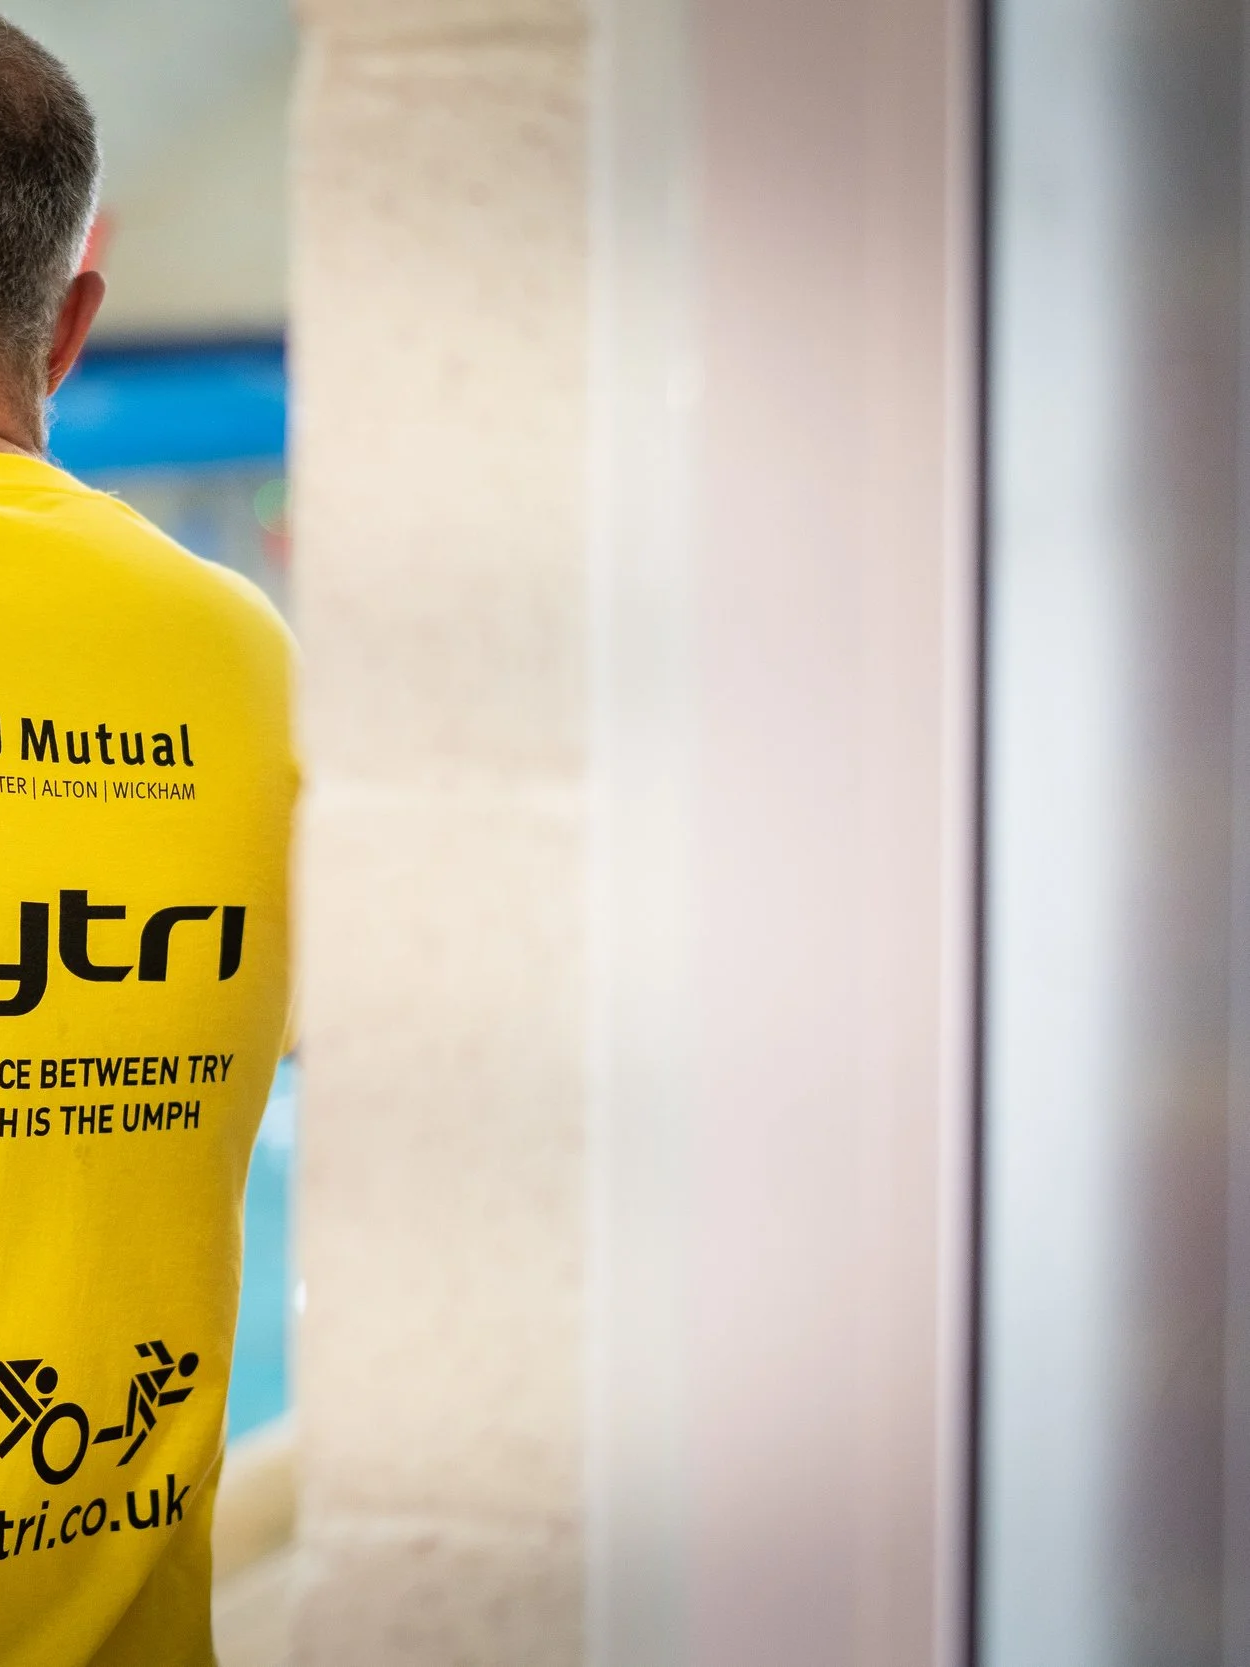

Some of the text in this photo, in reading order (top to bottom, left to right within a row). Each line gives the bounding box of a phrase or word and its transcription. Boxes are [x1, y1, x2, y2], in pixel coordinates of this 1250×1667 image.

[21, 717, 195, 767] Mutual
[41, 779, 98, 799] ALTON
[112, 781, 196, 801] WICKHAM
[40, 1056, 180, 1090] BETWEEN
[188, 1054, 235, 1084] TRY
[26, 1106, 51, 1138] IS
[60, 1103, 113, 1136] THE
[122, 1100, 201, 1132] UMPH
